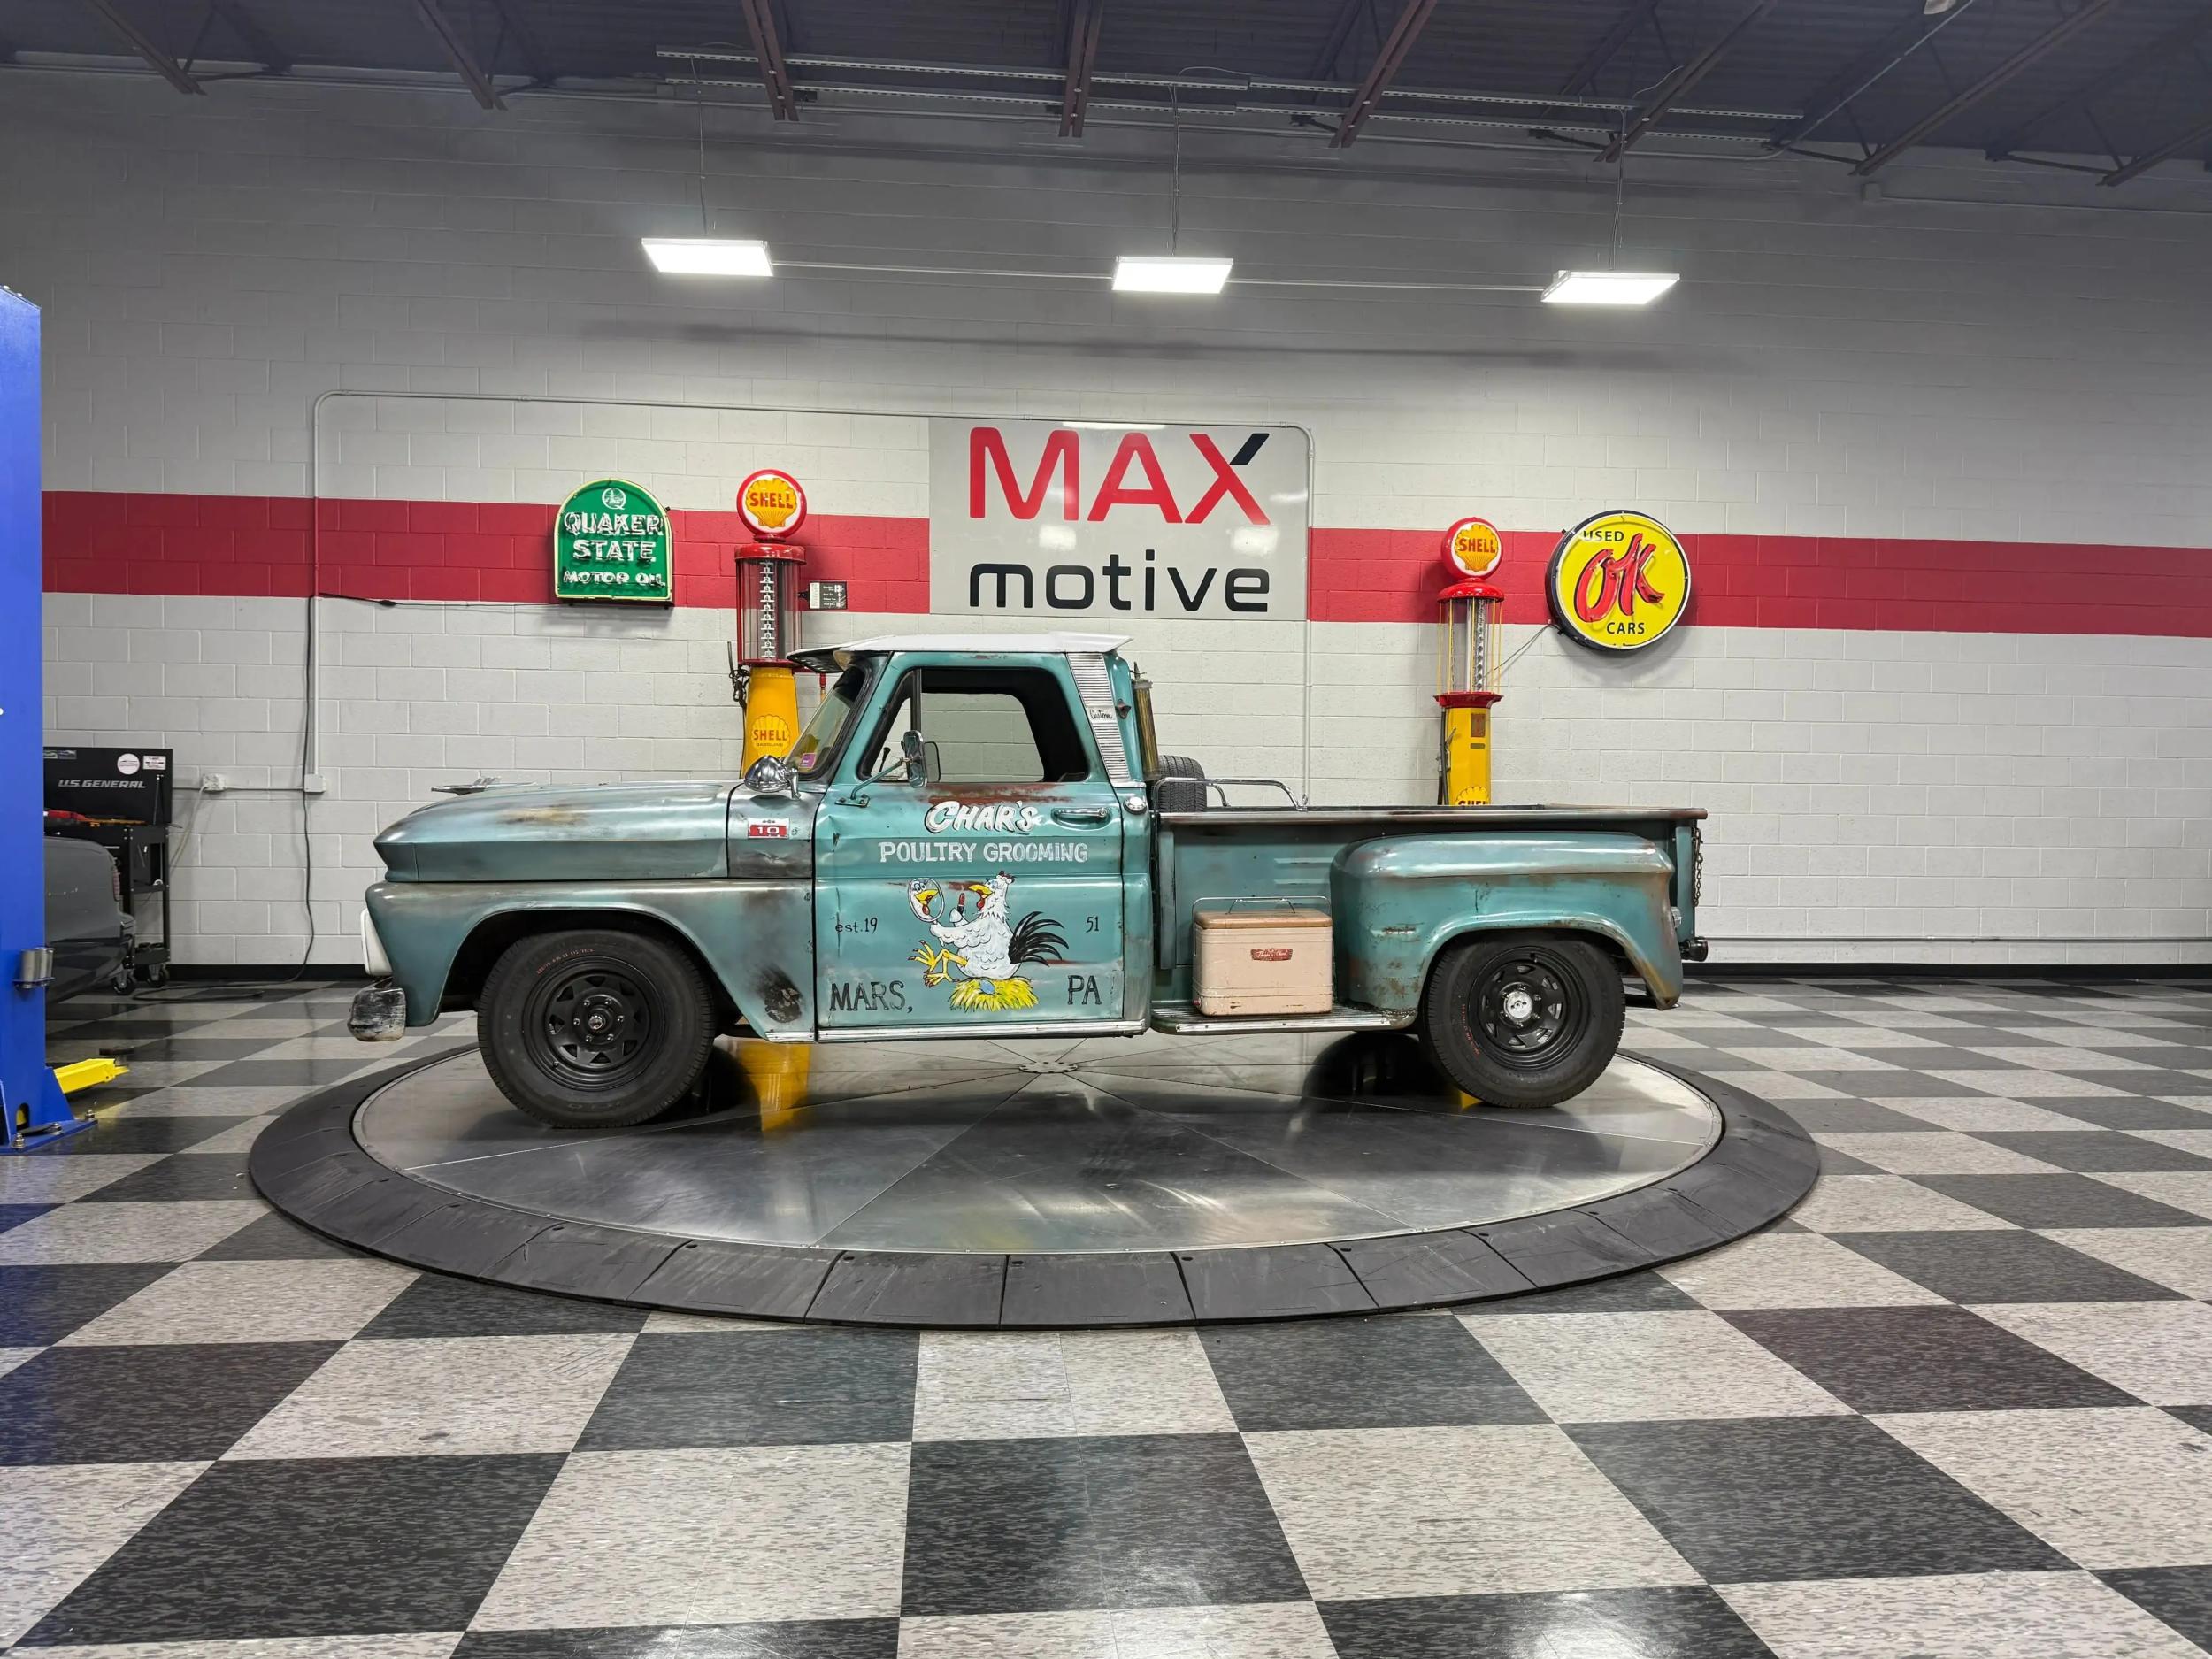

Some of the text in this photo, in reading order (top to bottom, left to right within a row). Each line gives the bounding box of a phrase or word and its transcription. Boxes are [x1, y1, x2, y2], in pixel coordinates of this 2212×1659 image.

[970, 426, 1271, 526] MAX
[749, 491, 794, 510] SHELL
[564, 511, 664, 536] QUAKER
[1583, 530, 1624, 542] USED
[572, 539, 657, 562] STATE
[1458, 537, 1496, 554] SHELL
[563, 570, 666, 587] MOTOR OIL
[970, 549, 1271, 613] motive
[1574, 533, 1665, 623] OK
[1606, 622, 1645, 634] CARS
[1089, 709, 1113, 719] Custom
[753, 729, 787, 741] SHELL
[81, 780, 147, 788] GENERAL
[925, 800, 1039, 835] CHAR'S
[757, 826, 780, 836] 10
[878, 841, 1088, 863] POULTRY GROOMING
[1086, 917, 1100, 933] 51
[829, 974, 1102, 1012] MARS, PA
